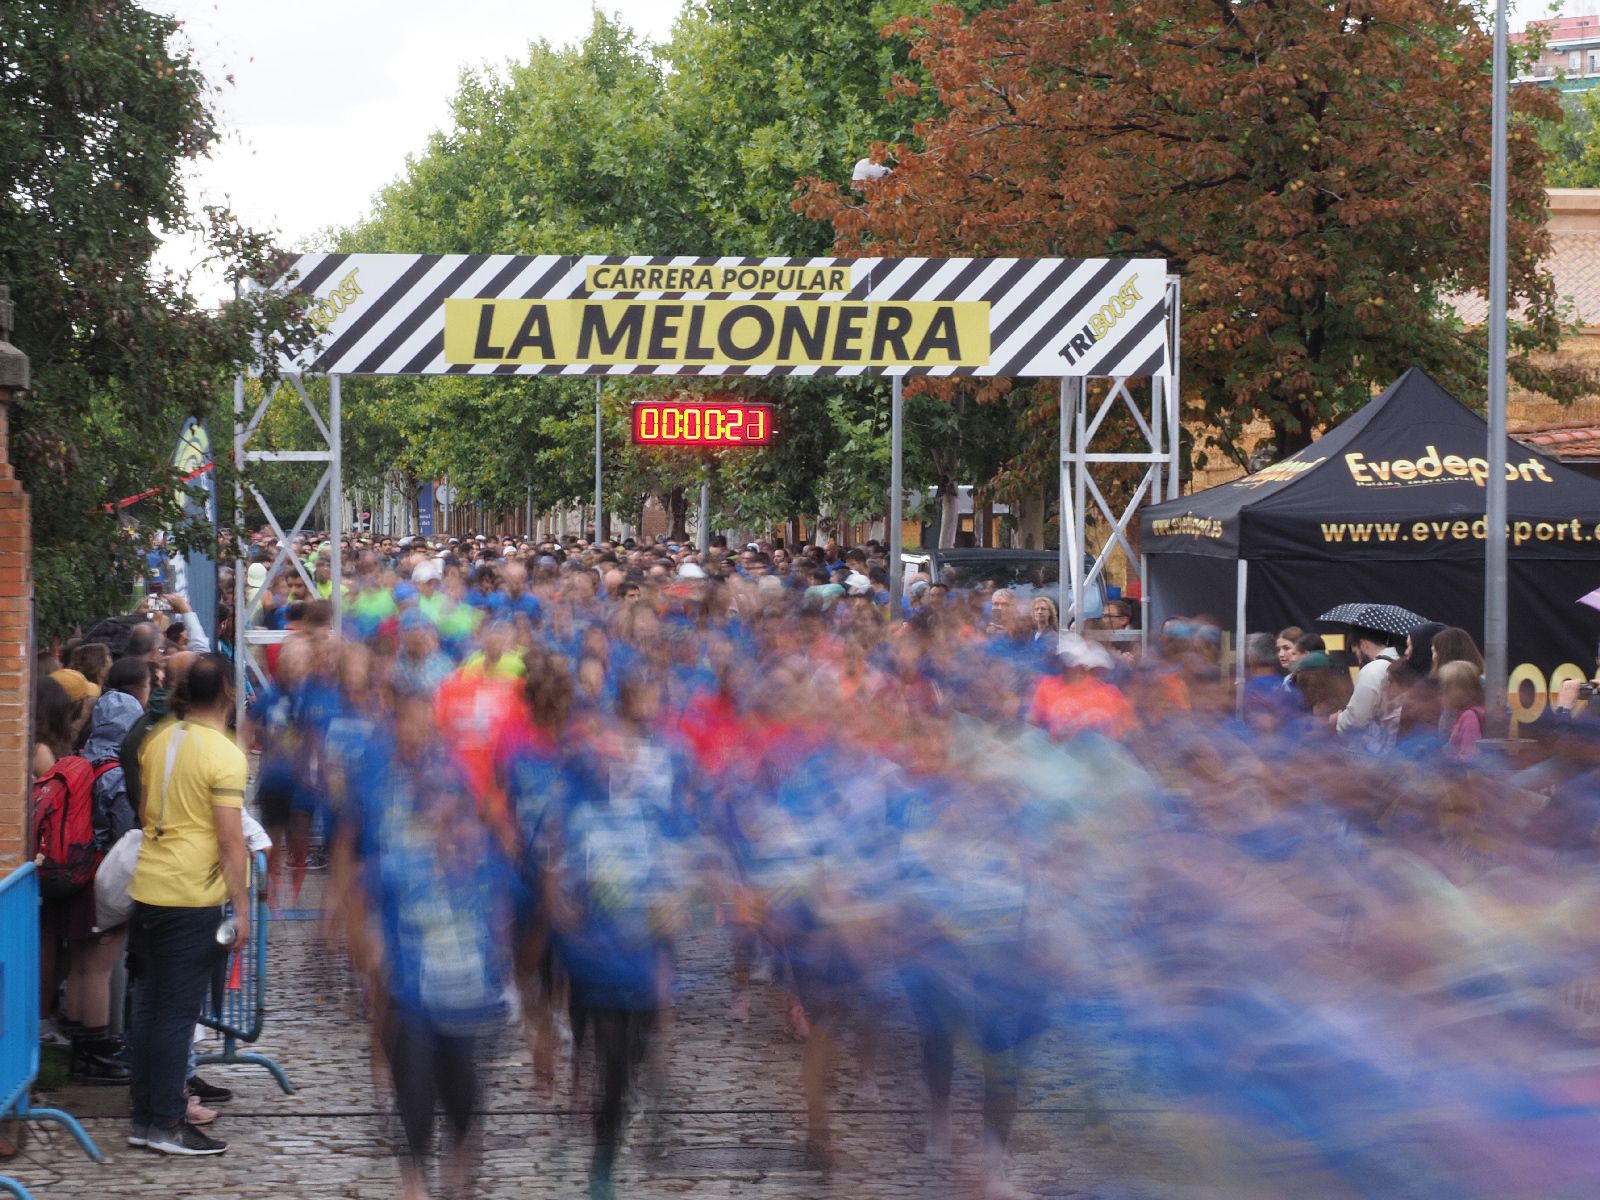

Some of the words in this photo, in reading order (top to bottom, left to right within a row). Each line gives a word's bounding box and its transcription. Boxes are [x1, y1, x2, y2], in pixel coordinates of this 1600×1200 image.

[593, 267, 714, 290] CARRERA
[721, 268, 845, 291] POPULAR
[474, 303, 556, 360] LA
[576, 303, 962, 361] MELONERA
[1321, 514, 1600, 546] www.evedport.
